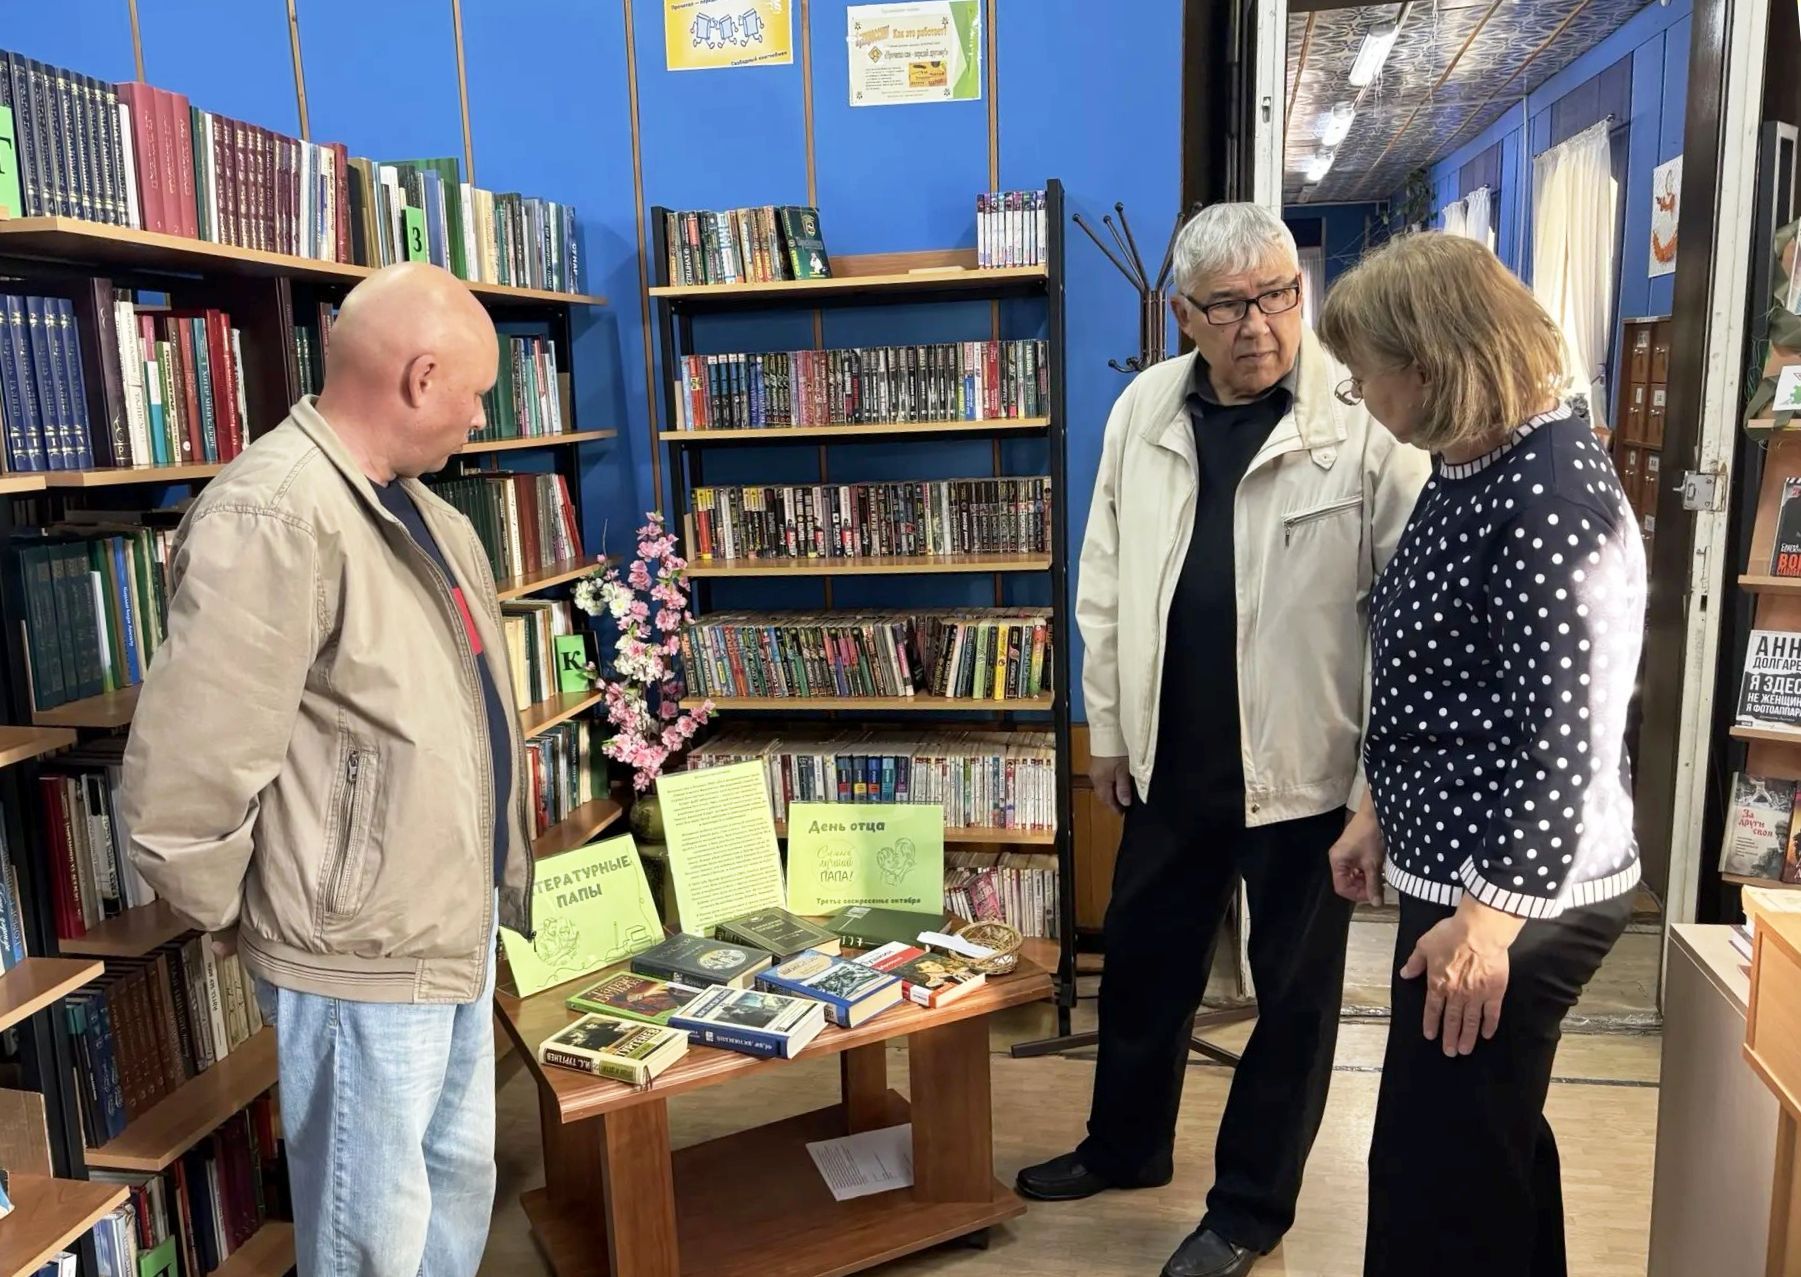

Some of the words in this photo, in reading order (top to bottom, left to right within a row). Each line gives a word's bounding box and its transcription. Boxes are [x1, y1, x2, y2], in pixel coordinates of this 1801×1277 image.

[1777, 553, 1801, 571] ВО
[560, 651, 582, 671] К
[1750, 675, 1760, 691] Я
[1747, 692, 1760, 703] НЕ
[1746, 703, 1752, 712] Я
[1742, 809, 1755, 819] За
[808, 820, 846, 834] День
[850, 821, 886, 833] отца
[1738, 818, 1765, 830] други
[1753, 828, 1773, 838] свои
[532, 855, 633, 896] ТЕРАТУРНЫЕ
[820, 870, 854, 882] ПАПА!
[556, 884, 603, 909] ПАПЫ
[891, 897, 921, 906] октября
[546, 1052, 580, 1069] ТУРГЕНЕВ
